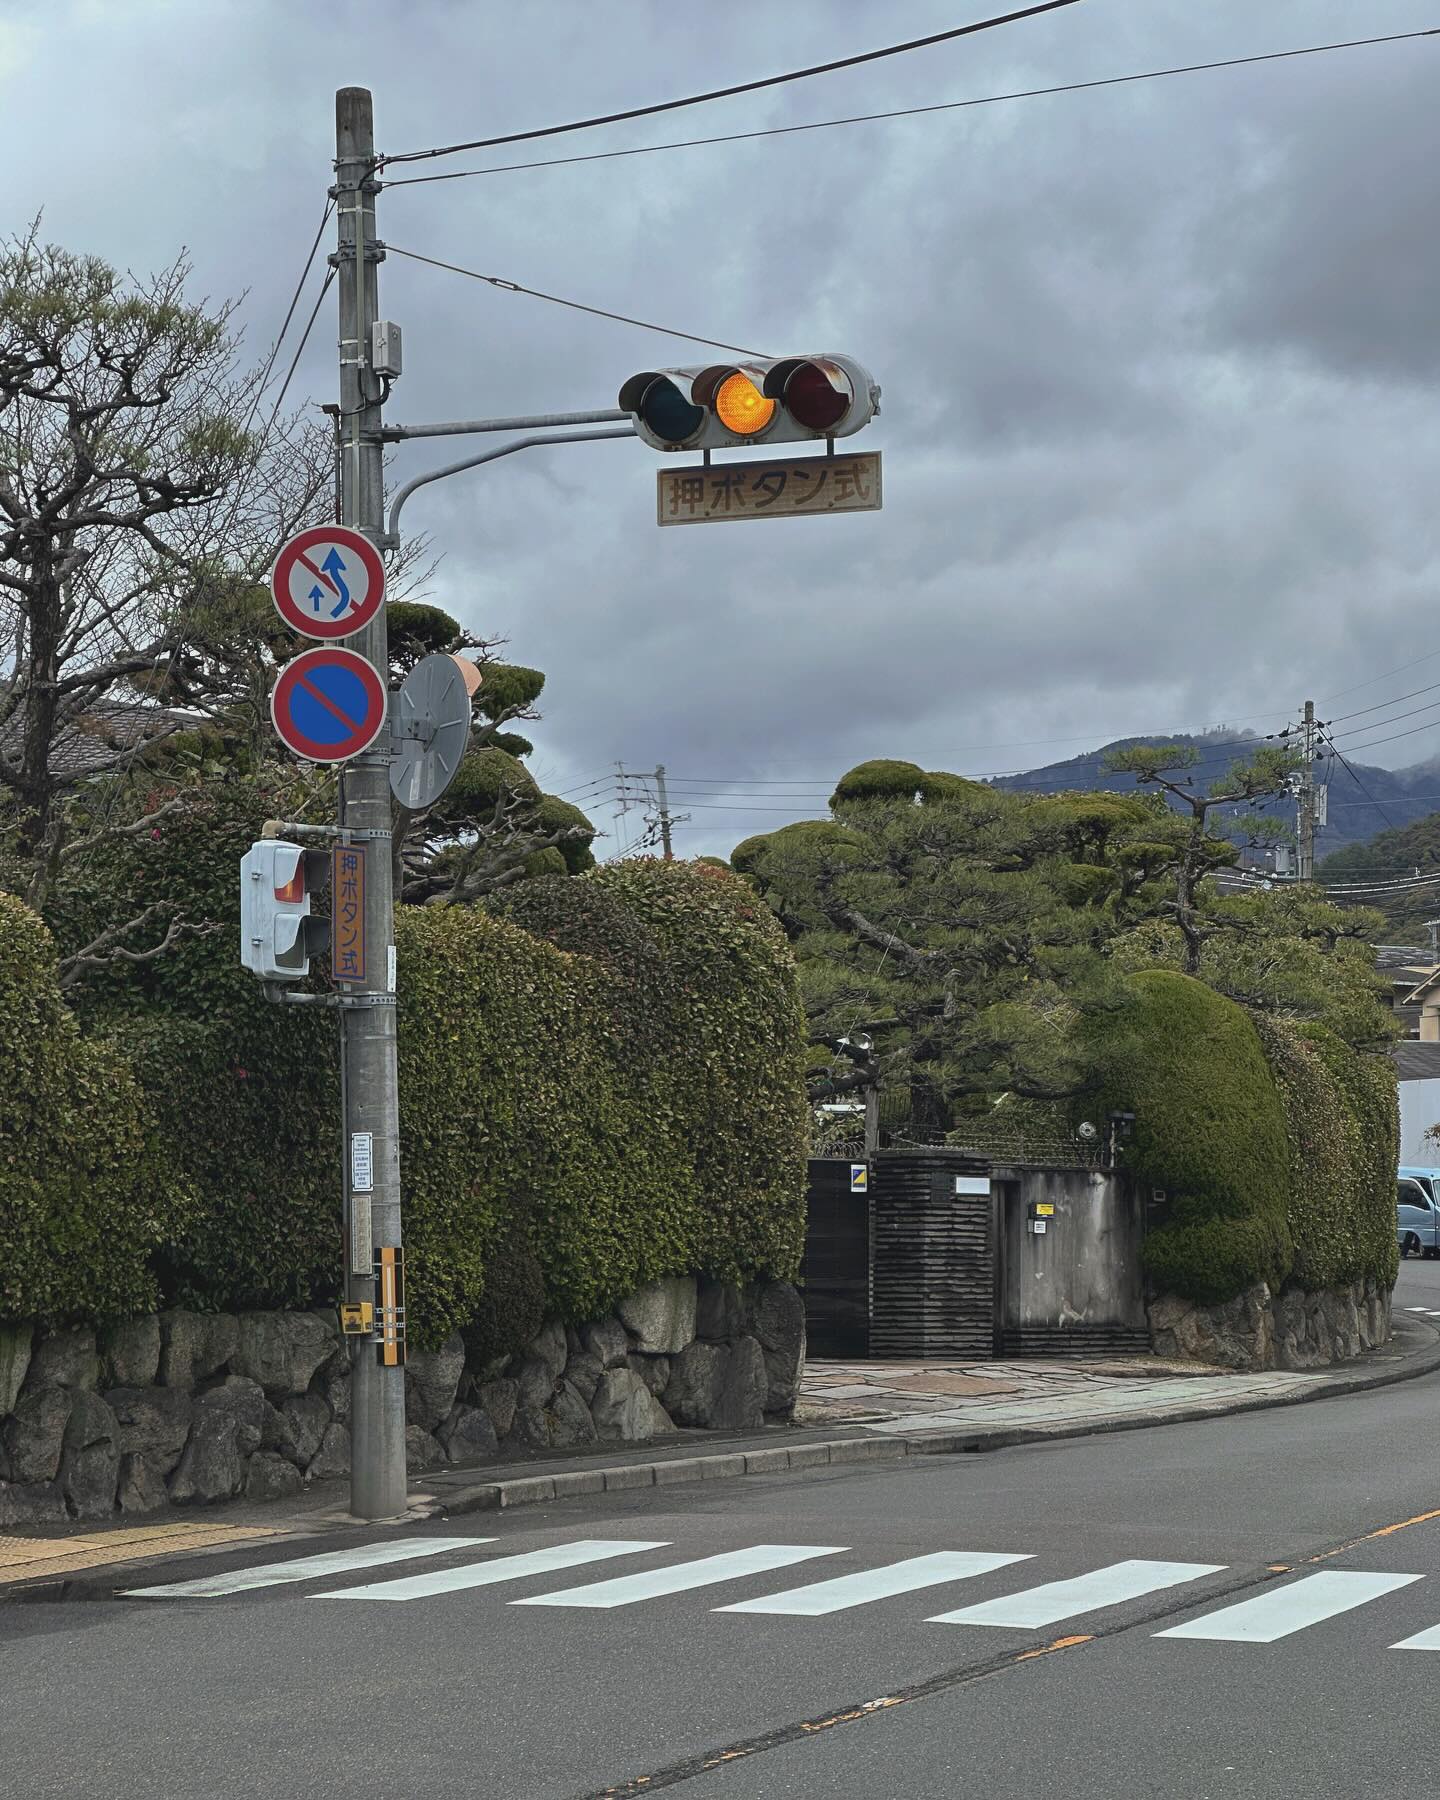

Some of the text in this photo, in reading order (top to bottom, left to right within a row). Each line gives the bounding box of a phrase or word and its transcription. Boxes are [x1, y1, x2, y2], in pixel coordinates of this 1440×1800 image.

[670, 463, 871, 515] 押ボタン式
